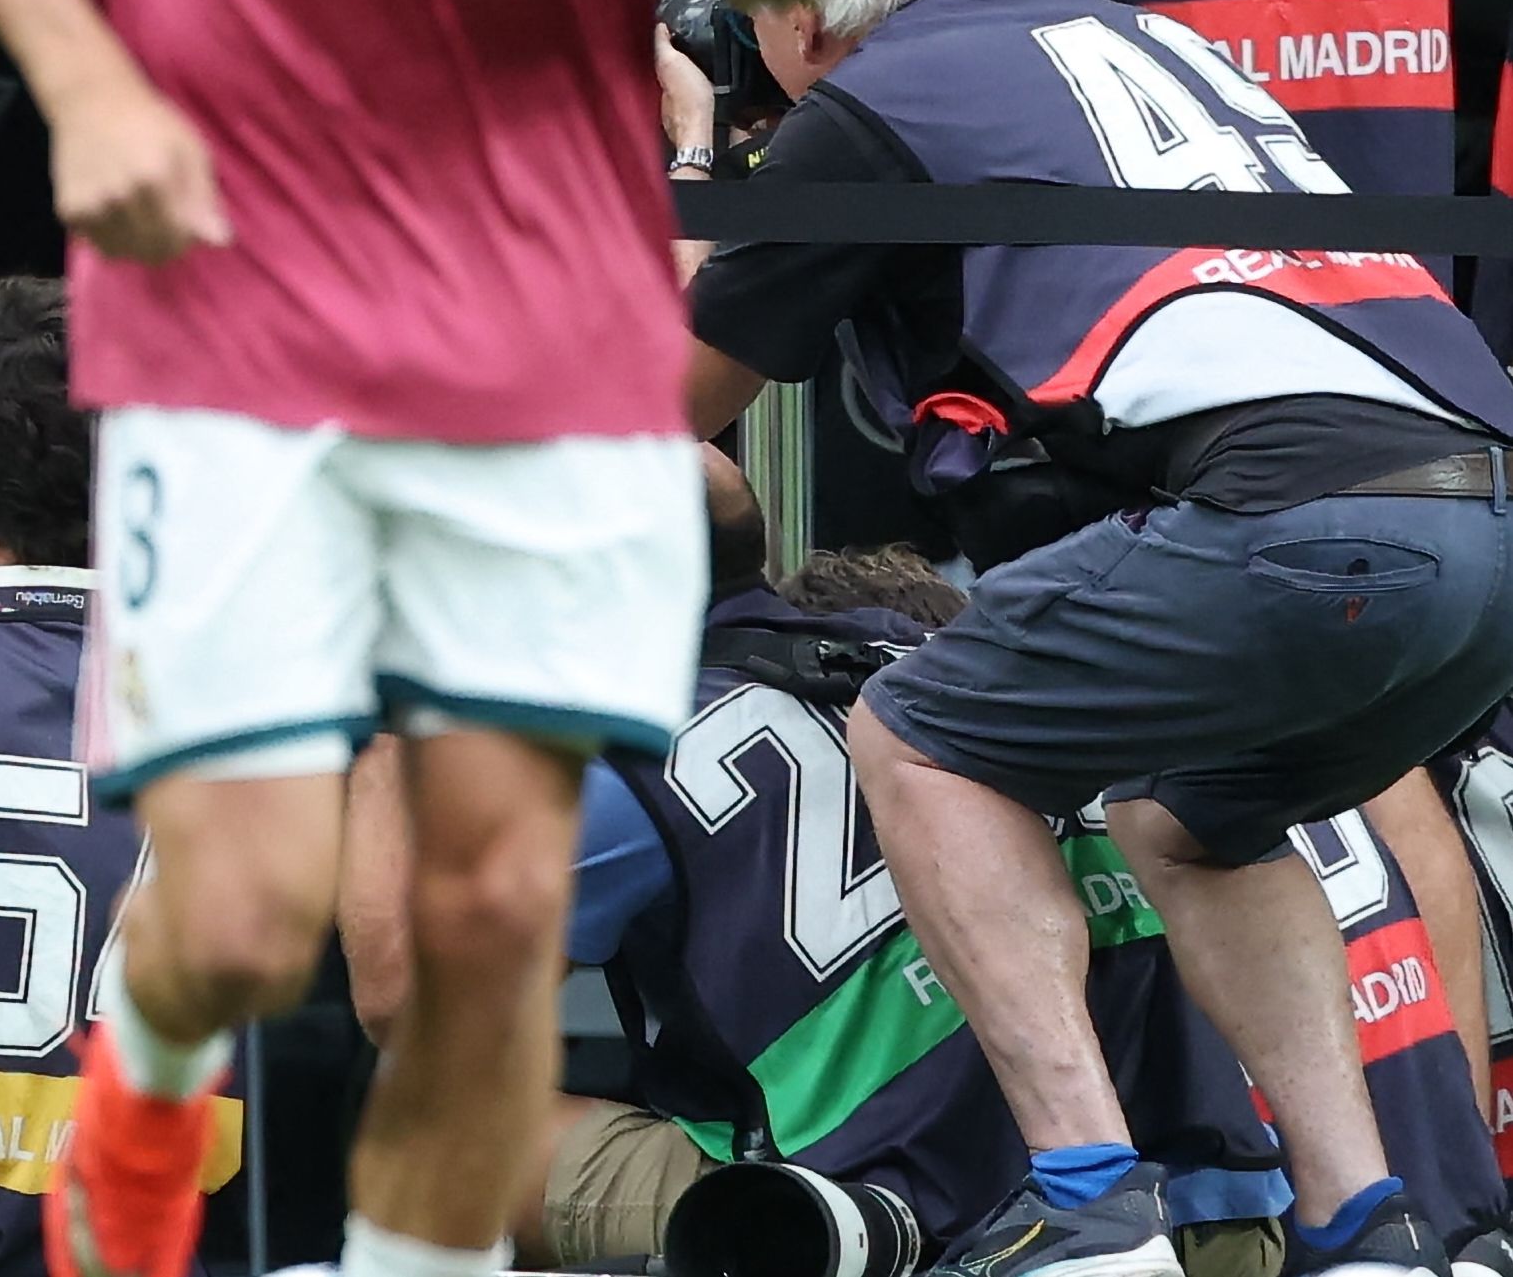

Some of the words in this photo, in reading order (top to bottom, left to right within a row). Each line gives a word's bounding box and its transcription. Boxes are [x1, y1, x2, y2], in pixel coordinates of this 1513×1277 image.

[1279, 27, 1449, 81] MADRID
[663, 682, 906, 983] 2
[1350, 956, 1426, 1024] ADRID
